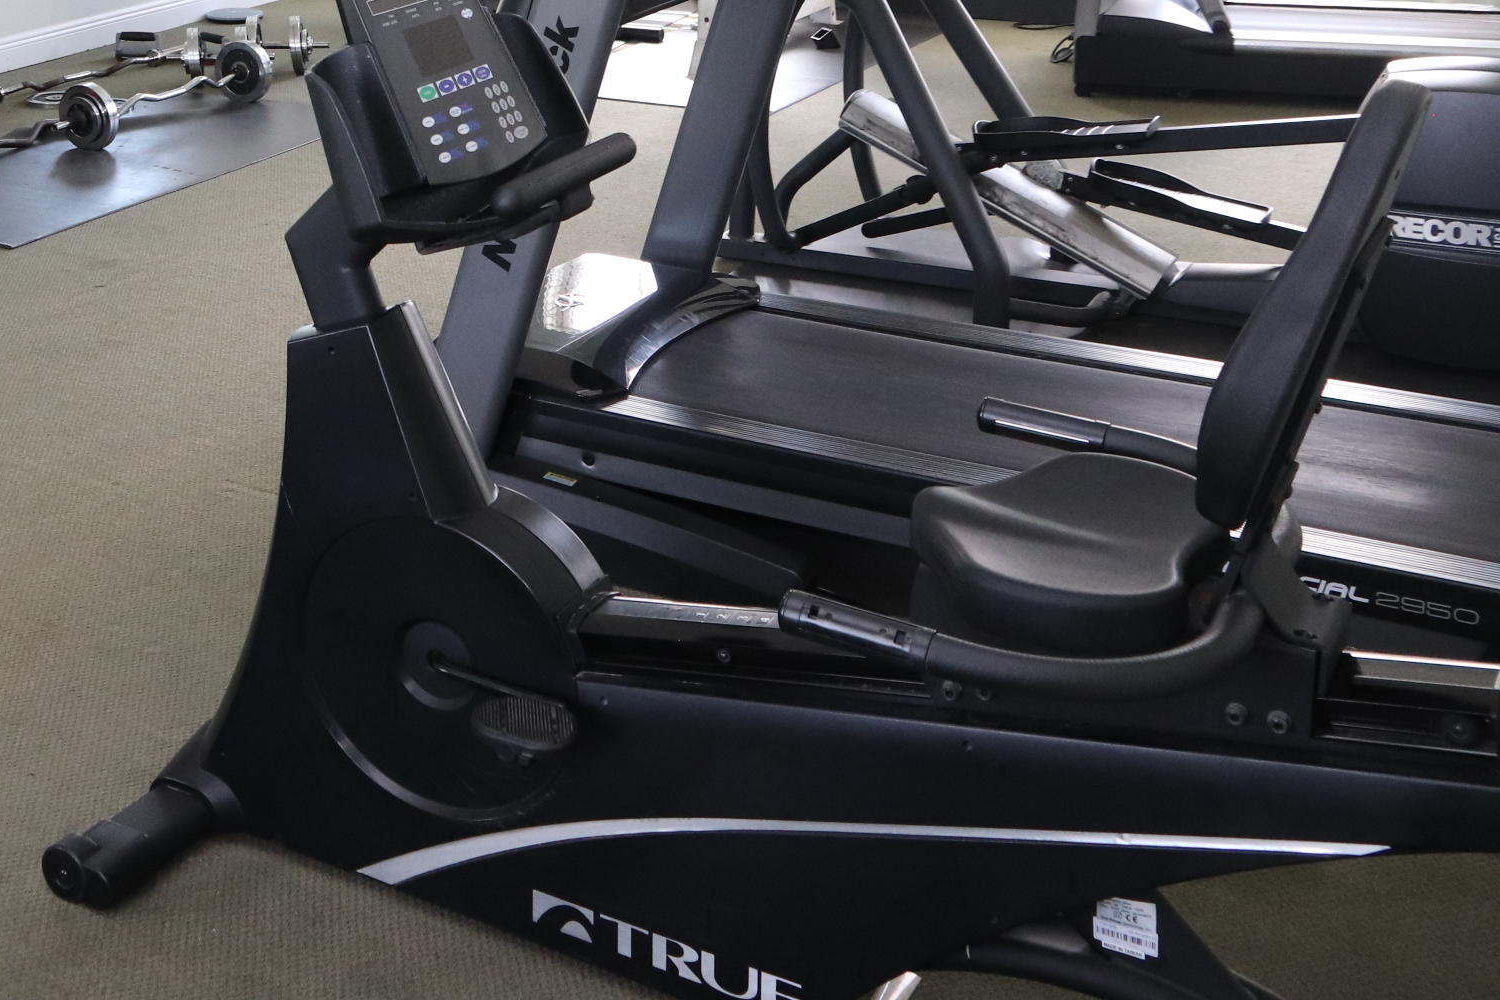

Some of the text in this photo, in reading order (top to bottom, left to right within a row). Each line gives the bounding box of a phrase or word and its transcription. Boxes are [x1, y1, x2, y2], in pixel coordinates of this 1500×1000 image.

[1387, 214, 1493, 248] RECOR
[1300, 575, 1480, 625] CIAL 2950
